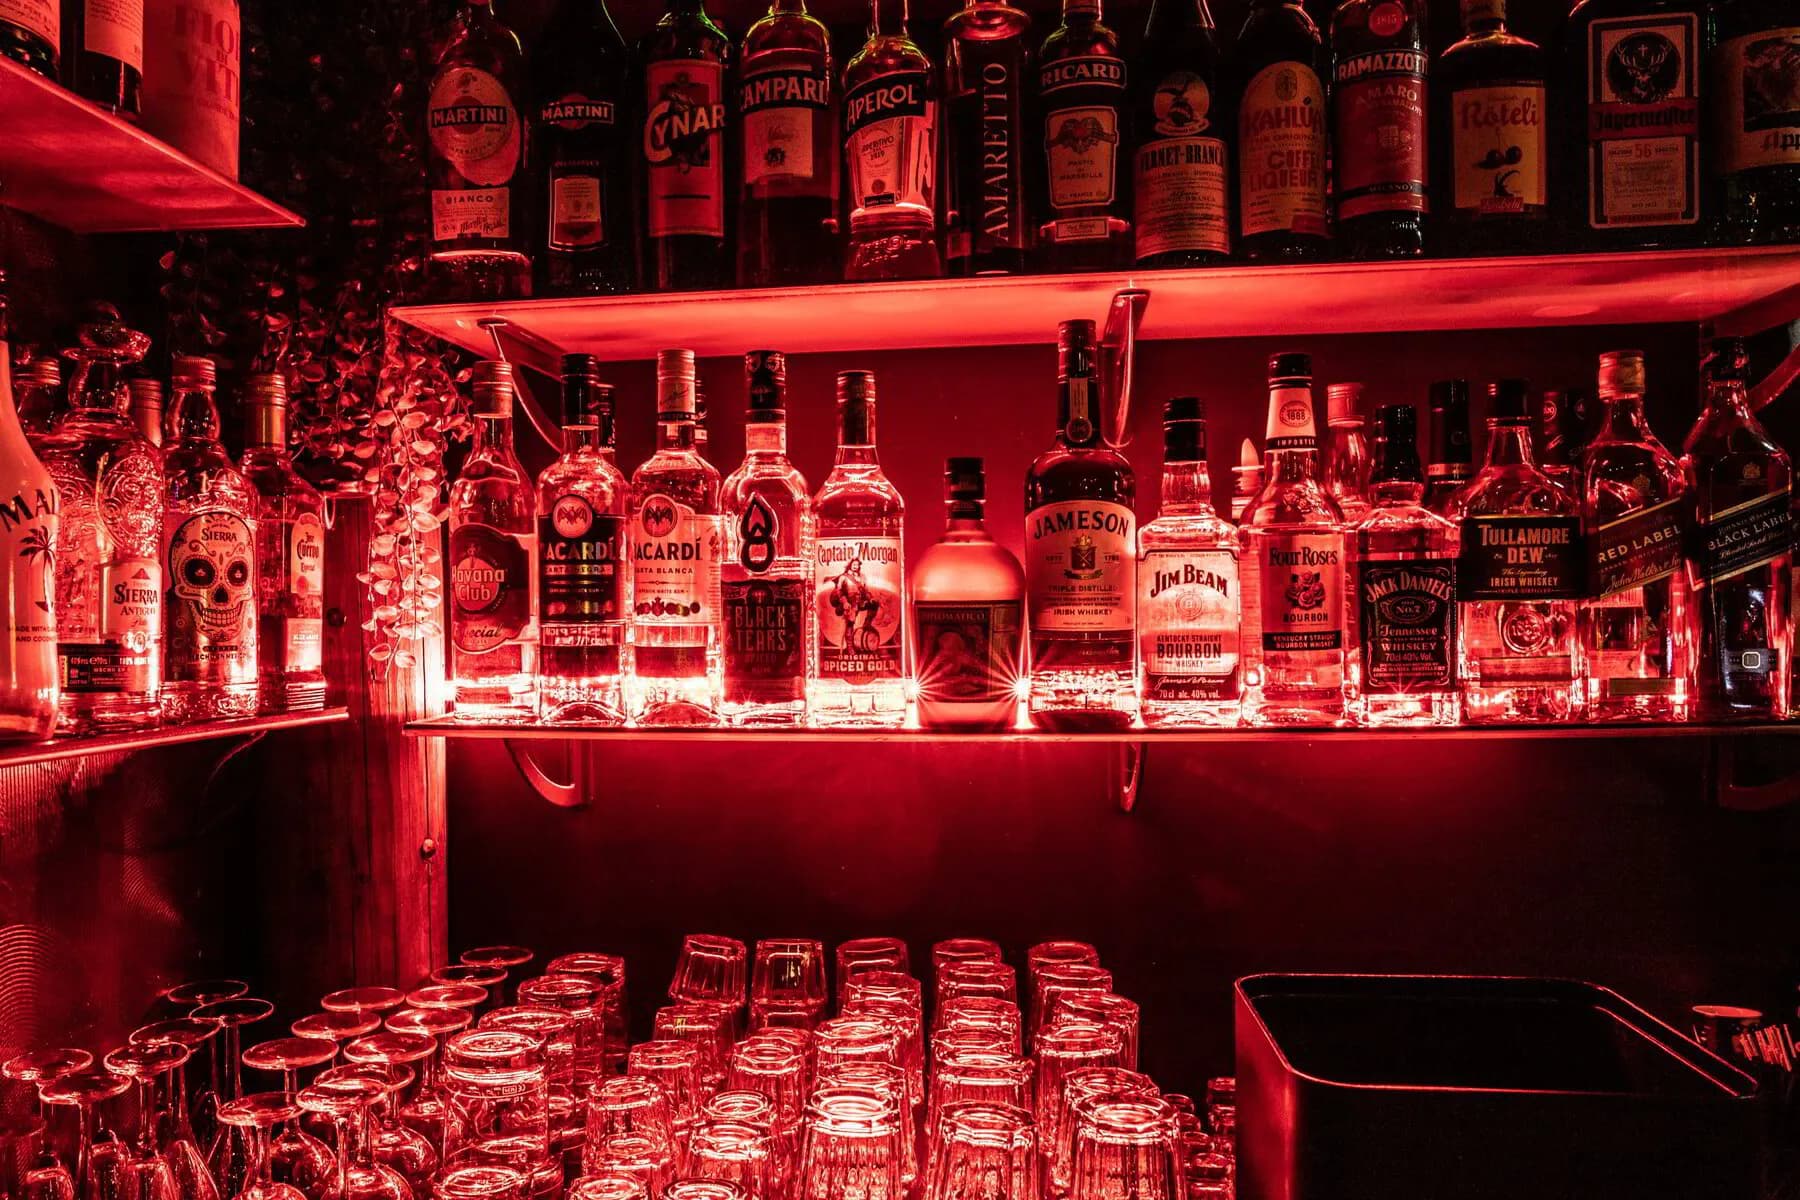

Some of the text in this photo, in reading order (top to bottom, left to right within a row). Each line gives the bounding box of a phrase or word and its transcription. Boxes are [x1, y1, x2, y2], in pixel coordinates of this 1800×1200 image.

[1042, 62, 1121, 88] RICARD
[1338, 52, 1429, 80] RAMAZZOTTI
[434, 108, 505, 126] MARTINI
[541, 105, 609, 121] MARTINI
[847, 83, 918, 131] APEROL
[644, 101, 726, 162] CYNAR
[983, 63, 1009, 242] AMARETTO
[202, 528, 238, 542] SIERRA
[1034, 509, 1129, 540] JAMESON
[1478, 524, 1570, 546] TULLAMORE
[540, 536, 616, 561] ACARDÍ
[635, 537, 702, 561] ACARDÍ
[818, 541, 898, 566] Captain Morgan
[1598, 523, 1681, 564] RED LABEL
[451, 565, 505, 584] Havana
[1150, 563, 1229, 600] JIM BEAM
[1490, 576, 1559, 588] IRISH WHISKEY
[113, 582, 158, 605] SIERRA
[457, 584, 490, 601] Club
[1366, 577, 1399, 602] JACK
[735, 606, 786, 628] BLACK
[1283, 613, 1329, 622] BOURBON
[735, 629, 786, 652] TEARS
[1156, 643, 1222, 659] BOURBON
[1381, 642, 1438, 651] WHISKEY
[823, 660, 896, 672] SPICED GOLD
